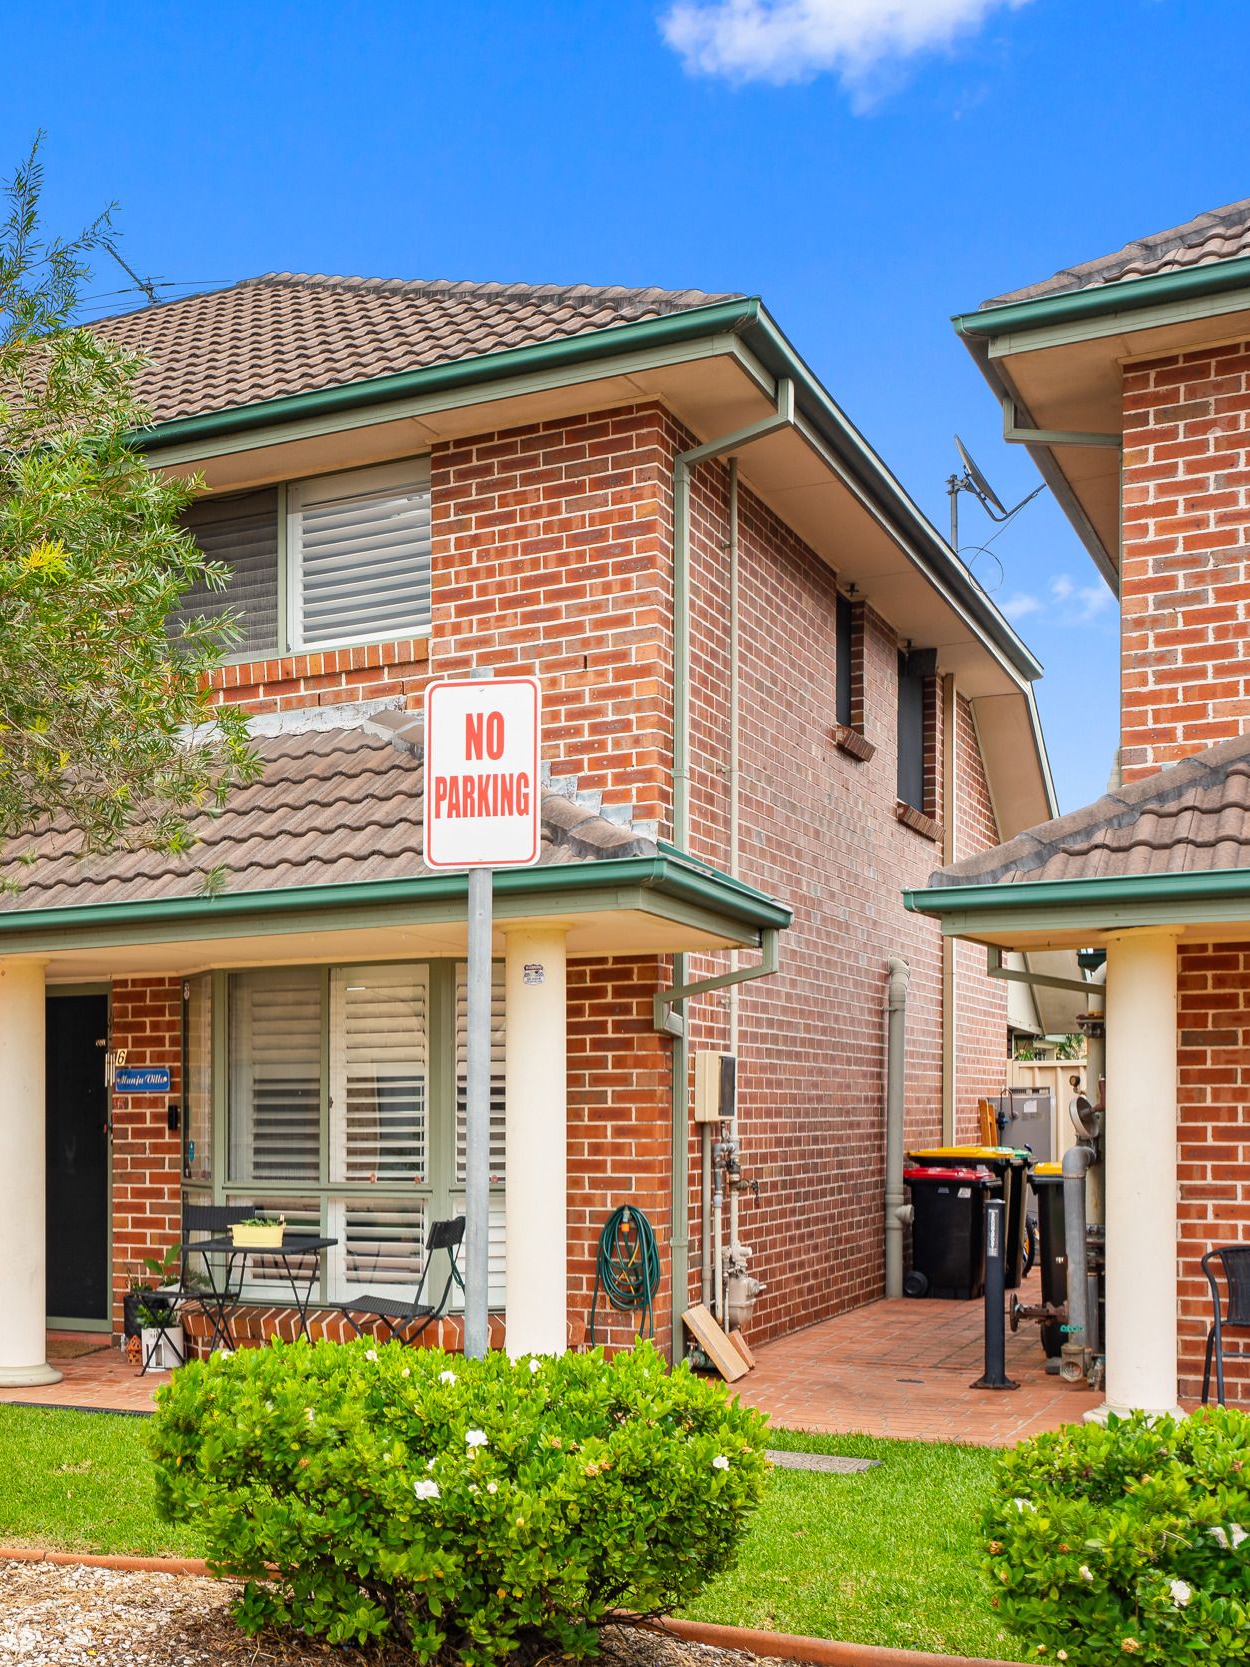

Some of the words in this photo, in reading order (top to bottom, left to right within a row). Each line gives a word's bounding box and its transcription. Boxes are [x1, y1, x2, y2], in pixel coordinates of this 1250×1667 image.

[465, 711, 505, 761] NO
[434, 771, 530, 820] PARKING
[117, 1050, 126, 1065] 6
